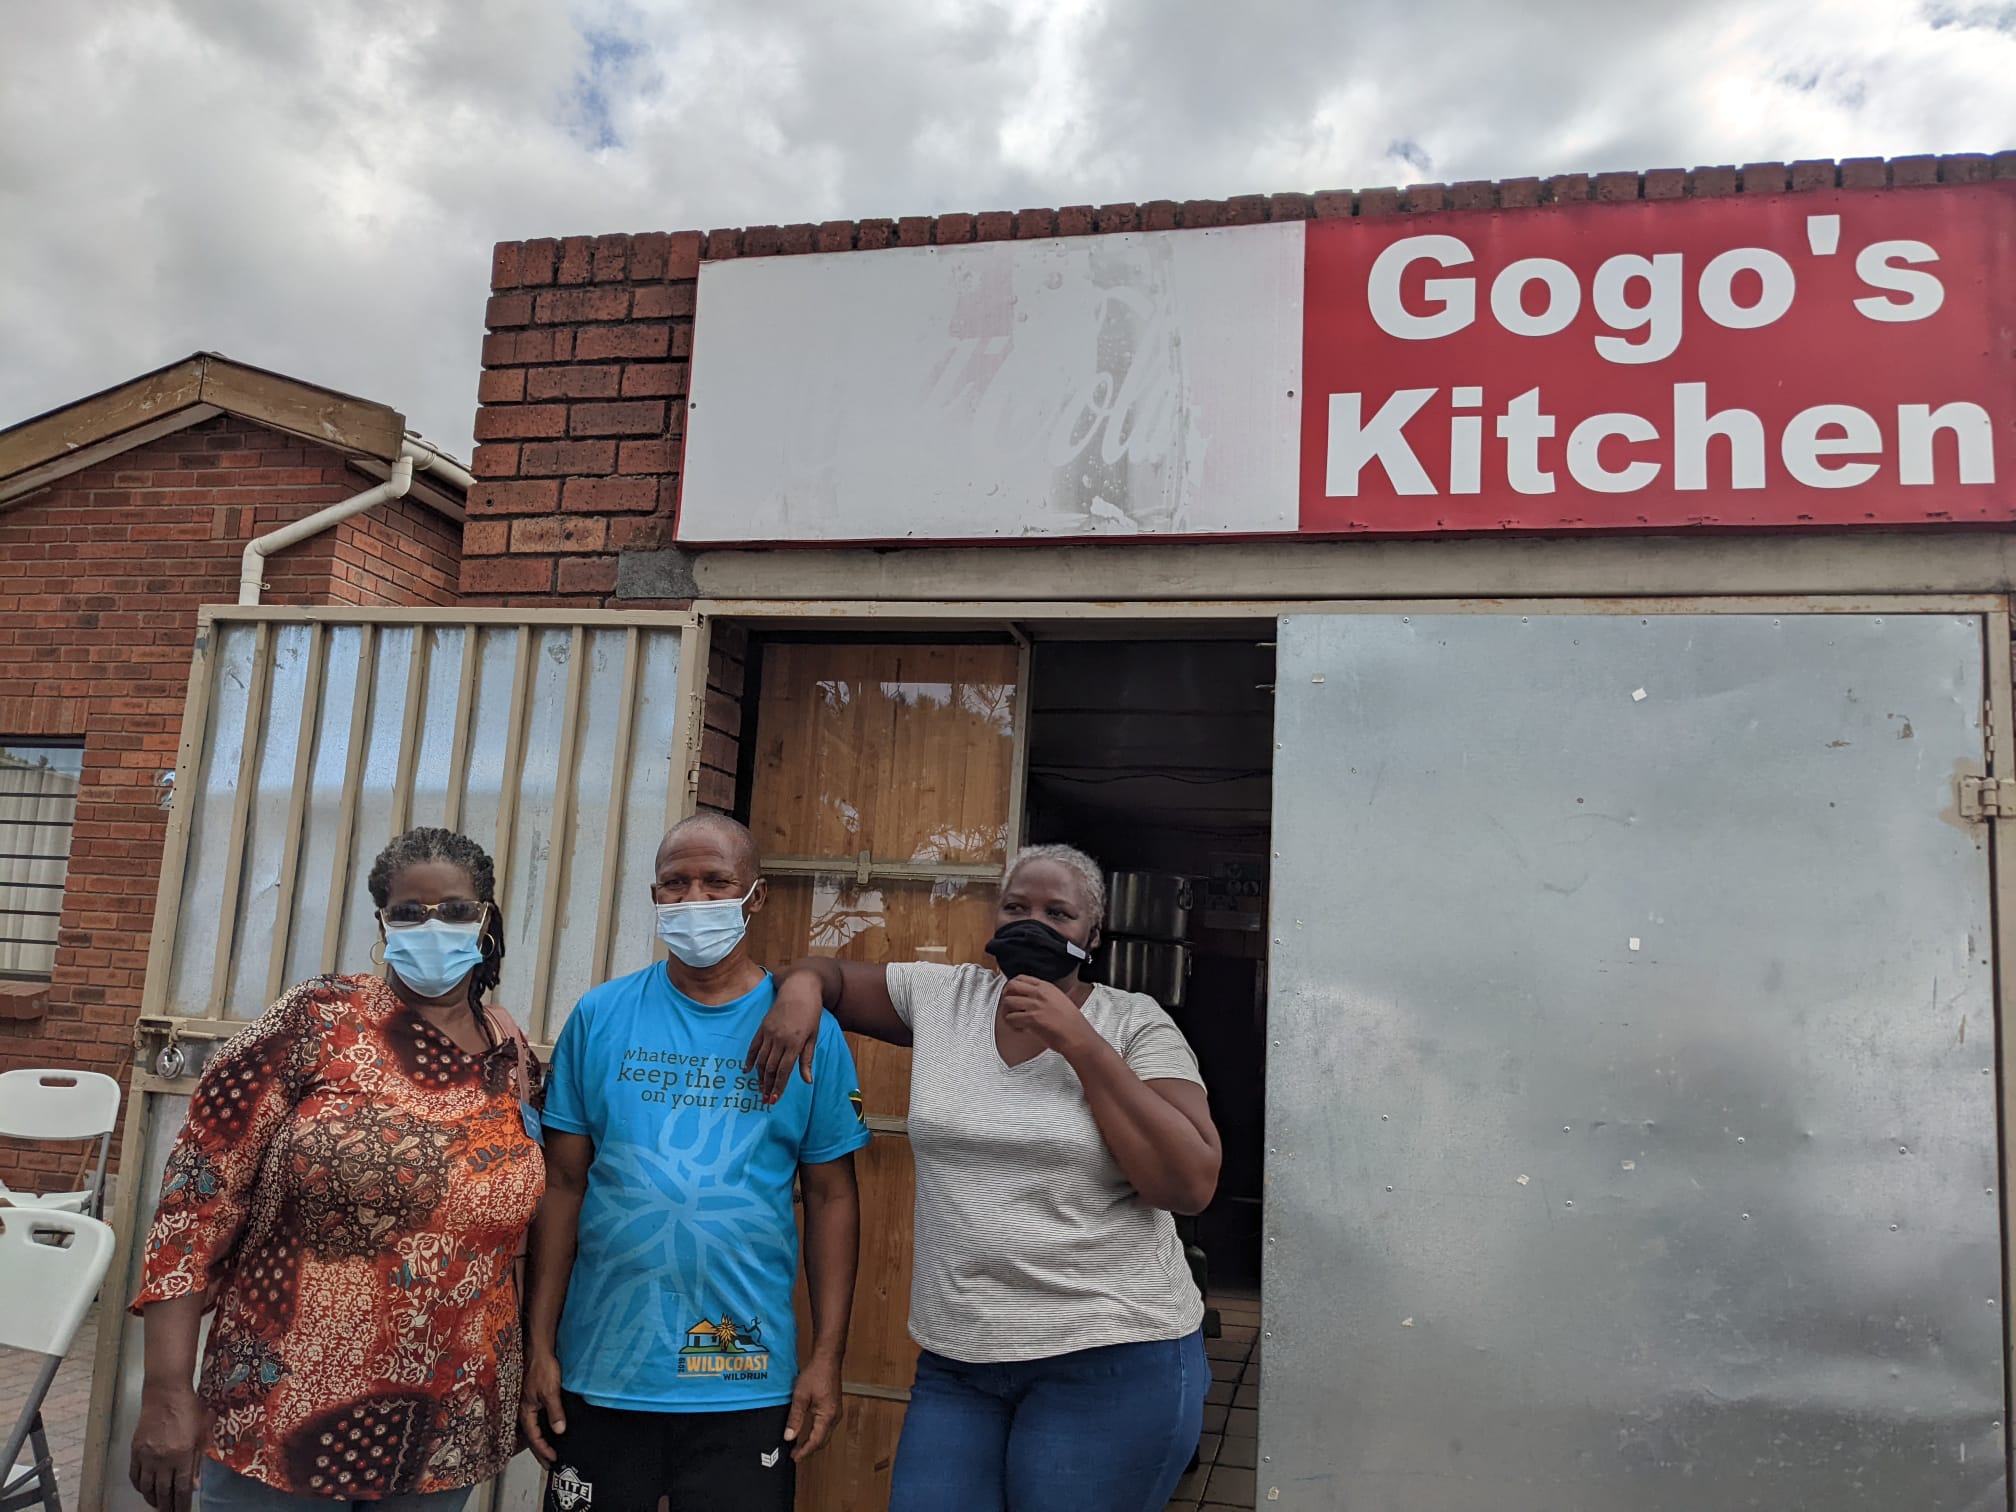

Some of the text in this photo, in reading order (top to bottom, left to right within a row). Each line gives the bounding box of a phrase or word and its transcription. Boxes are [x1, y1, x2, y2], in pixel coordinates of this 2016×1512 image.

[1367, 214, 1945, 364] Gogo's
[1325, 382, 1995, 497] Kitchen
[623, 1046, 709, 1068] whatever
[617, 1062, 760, 1092] keep the se
[641, 1088, 665, 1104] on
[672, 1093, 718, 1111] your
[686, 1354, 769, 1373] WILDCOAST
[723, 1371, 768, 1381] WILDRUN
[553, 1477, 589, 1497] ELITE
